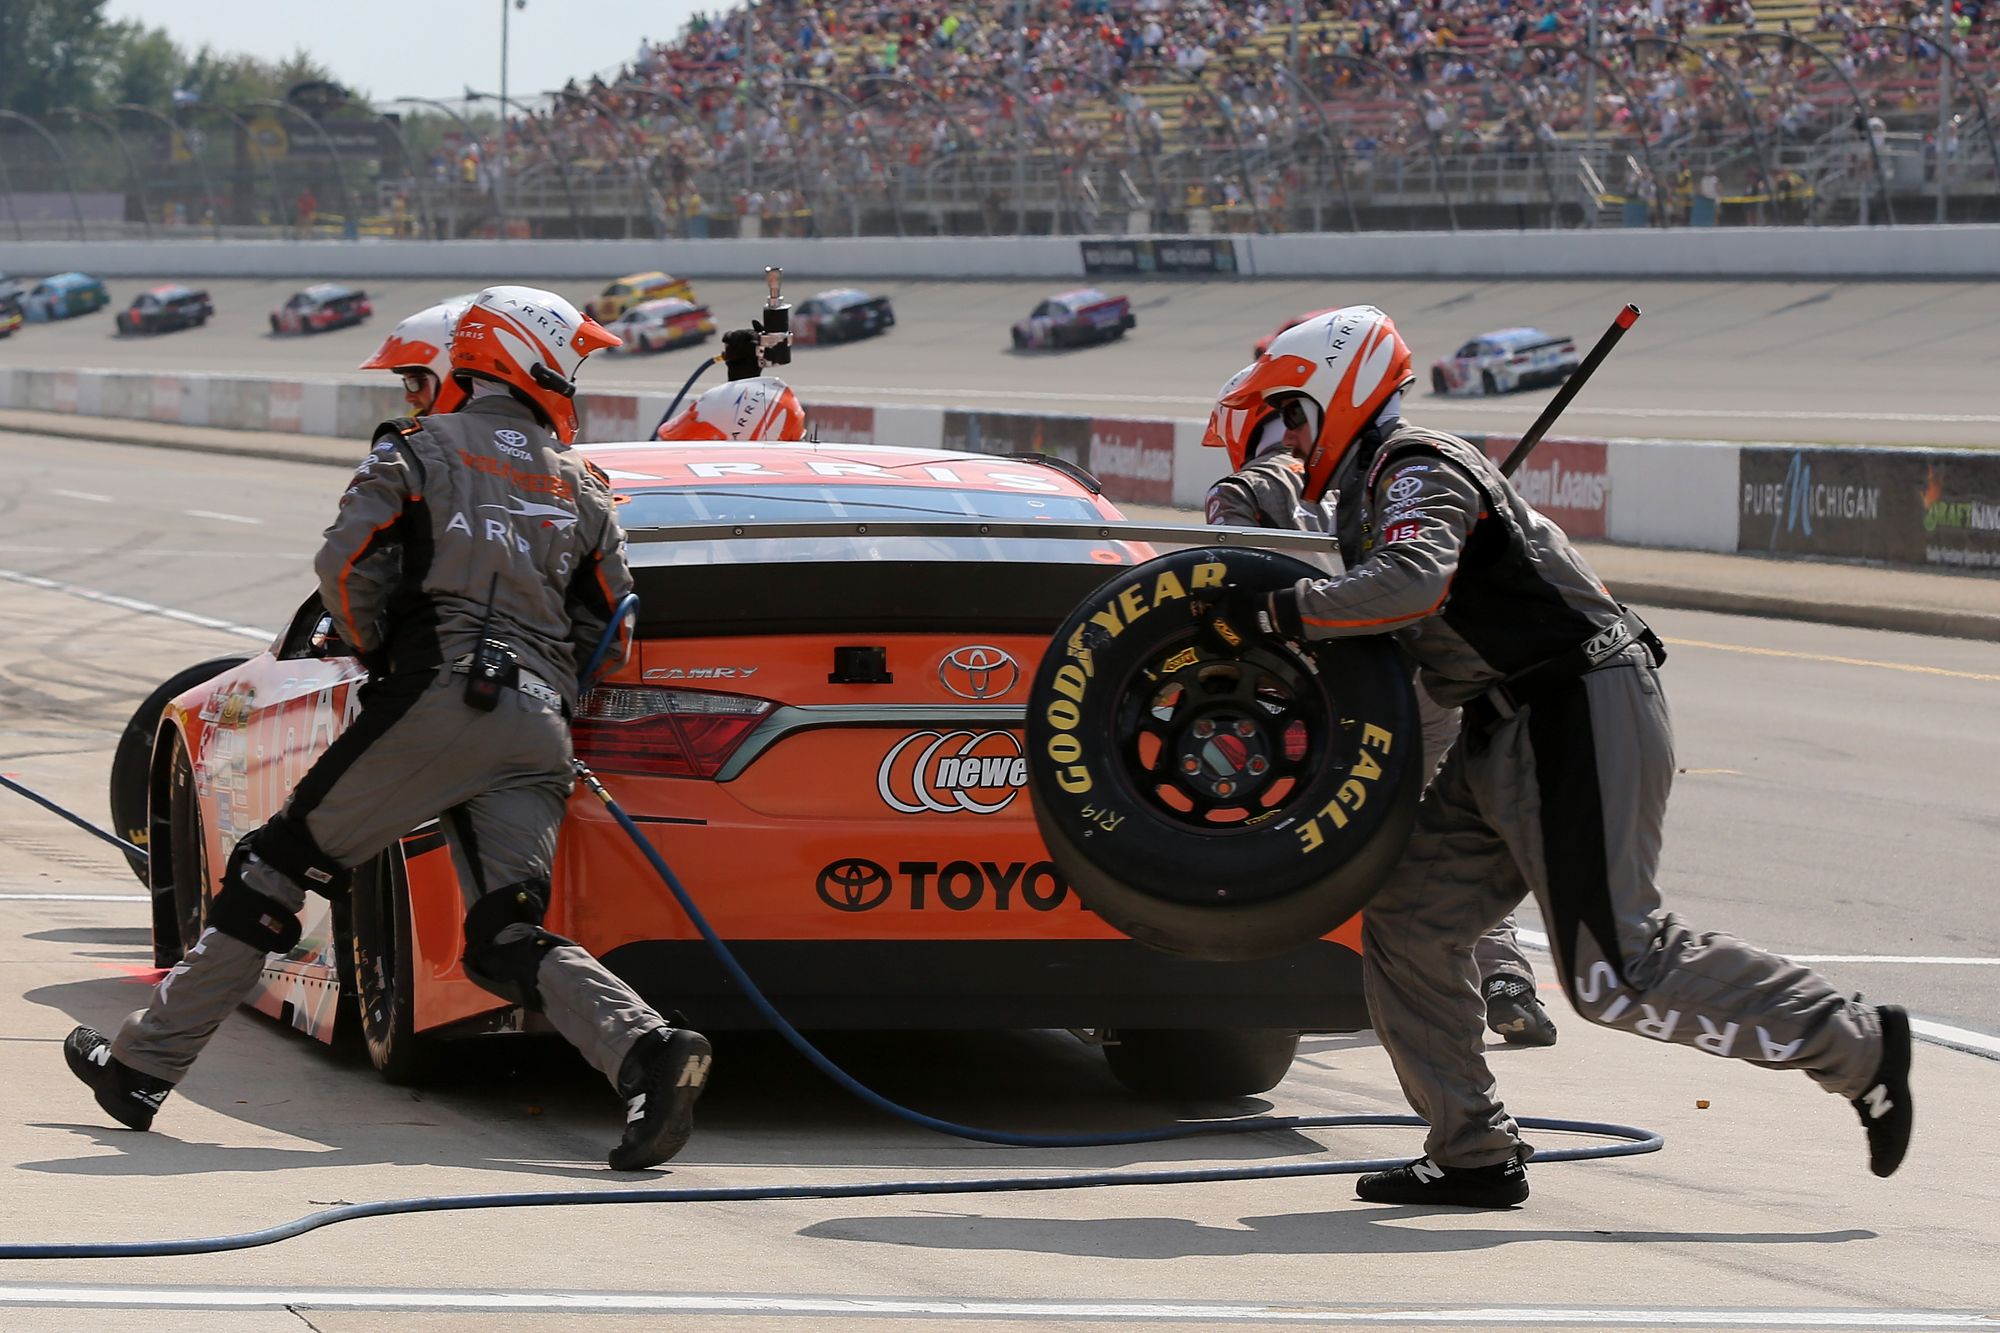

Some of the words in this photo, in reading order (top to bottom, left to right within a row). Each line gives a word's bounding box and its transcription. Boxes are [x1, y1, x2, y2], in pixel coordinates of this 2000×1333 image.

[503, 299, 566, 347] ARRIS
[1324, 314, 1365, 369] ARRIS
[731, 390, 765, 440] ARRIS
[494, 439, 533, 462] TOYOTA
[1743, 482, 1783, 516] PURE
[1771, 450, 1881, 547] MICHIGAN
[445, 511, 573, 575] ARRS
[643, 665, 758, 680] CAMRY
[1047, 562, 1227, 794] GOODYEAR
[935, 755, 1028, 789] newe
[1294, 721, 1393, 854] EAGLE
[898, 860, 1100, 911] TOYO
[1575, 960, 1802, 1063] ARRIS
[1411, 1159, 1446, 1185] N
